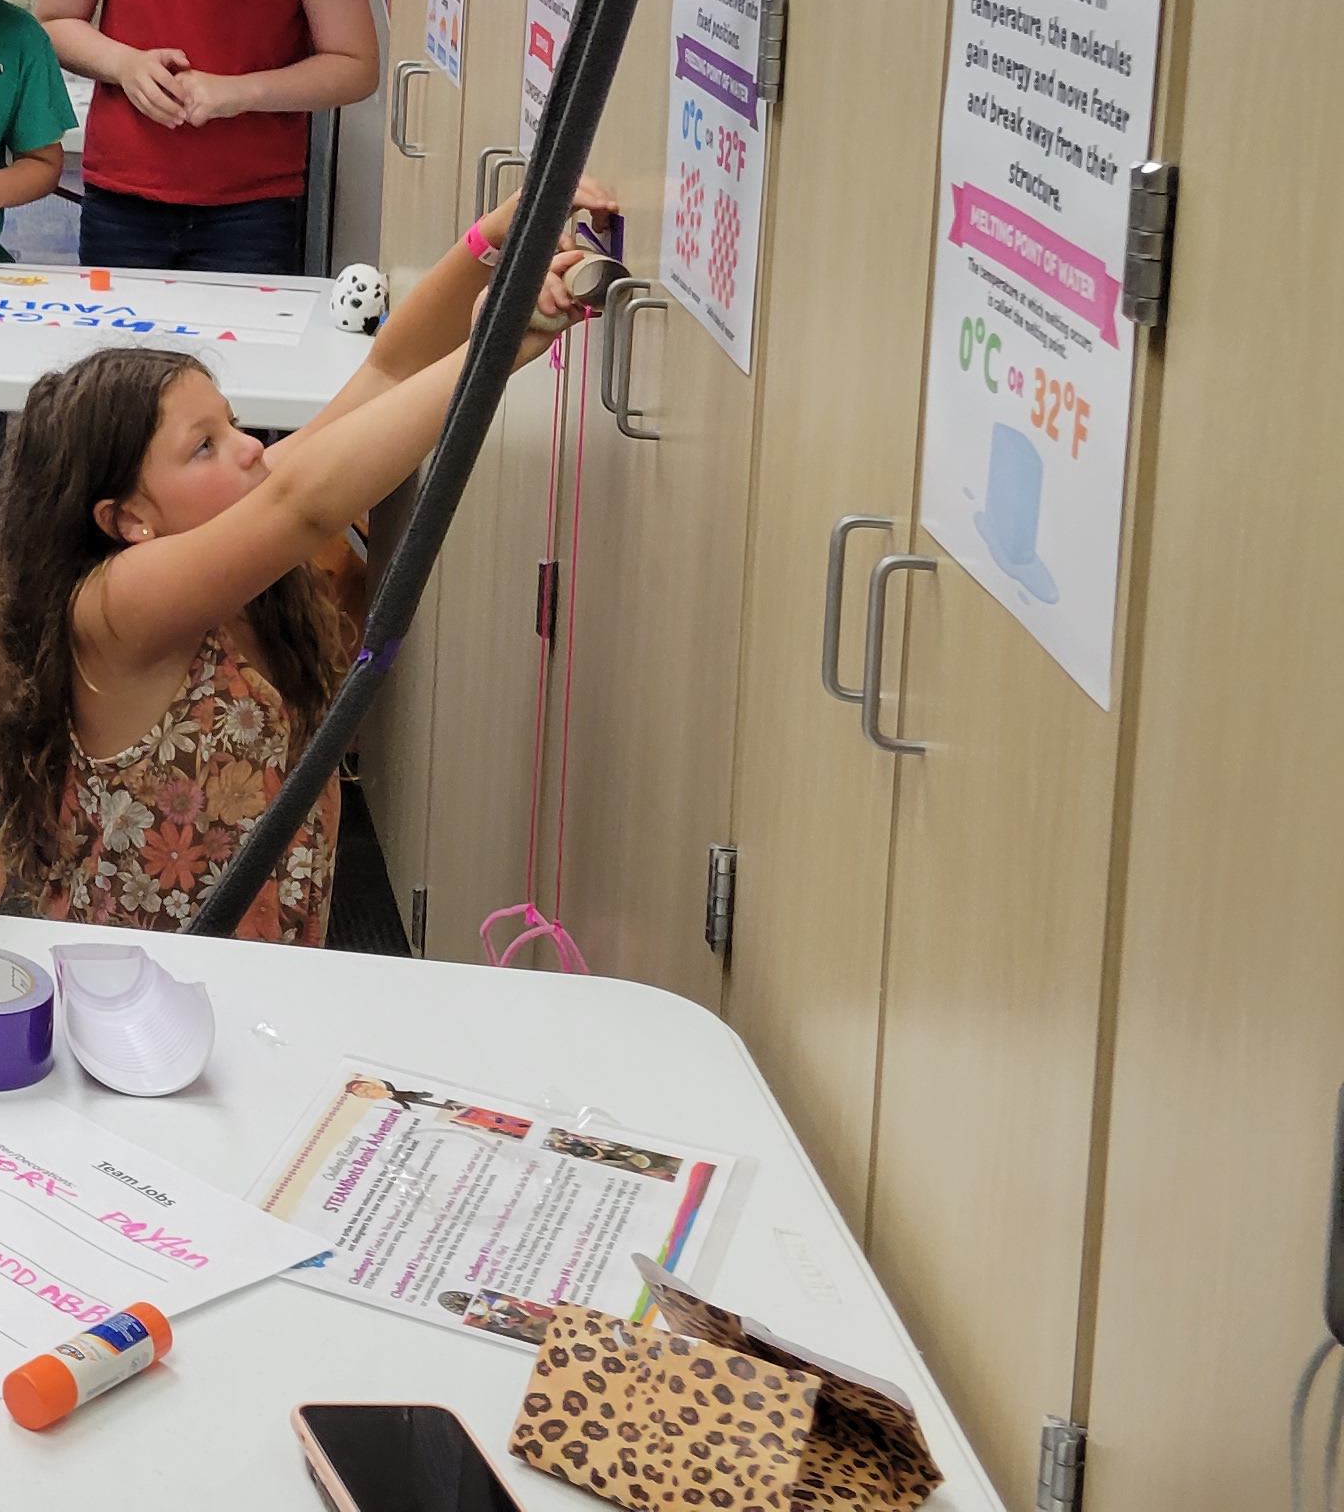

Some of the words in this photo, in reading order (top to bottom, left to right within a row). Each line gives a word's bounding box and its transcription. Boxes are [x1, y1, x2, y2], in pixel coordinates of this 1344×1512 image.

[697, 7, 711, 33] fixed
[1048, 16, 1067, 50] the
[1070, 29, 1132, 78] molecules
[965, 40, 988, 69] gain
[992, 52, 1032, 93] energy
[1034, 67, 1056, 98] and
[1057, 80, 1088, 115] move
[1090, 88, 1130, 134] faster
[967, 91, 989, 119] and
[990, 94, 1024, 136] break
[1026, 118, 1054, 157] away
[1055, 126, 1082, 169] from
[1086, 144, 1118, 186] their
[1008, 160, 1062, 214] structure.
[970, 204, 1014, 248] MELTING
[1014, 228, 1043, 267] POINT
[1043, 249, 1057, 277] OF
[1058, 256, 1096, 303] WATER
[1007, 364, 1025, 399] OR
[1030, 367, 1091, 460] 32°F
[97, 1161, 138, 1185] Team
[138, 1183, 176, 1207] Jobs
[322, 1166, 364, 1212] STEAMbots
[351, 1146, 378, 1167] Bank
[366, 1108, 402, 1147] Adventure
[348, 1257, 374, 1285] Challenge
[390, 1270, 415, 1298] Challenge
[464, 1253, 488, 1282] Challenge
[546, 1276, 570, 1305] Challenge
[37, 1284, 111, 1324] ABB
